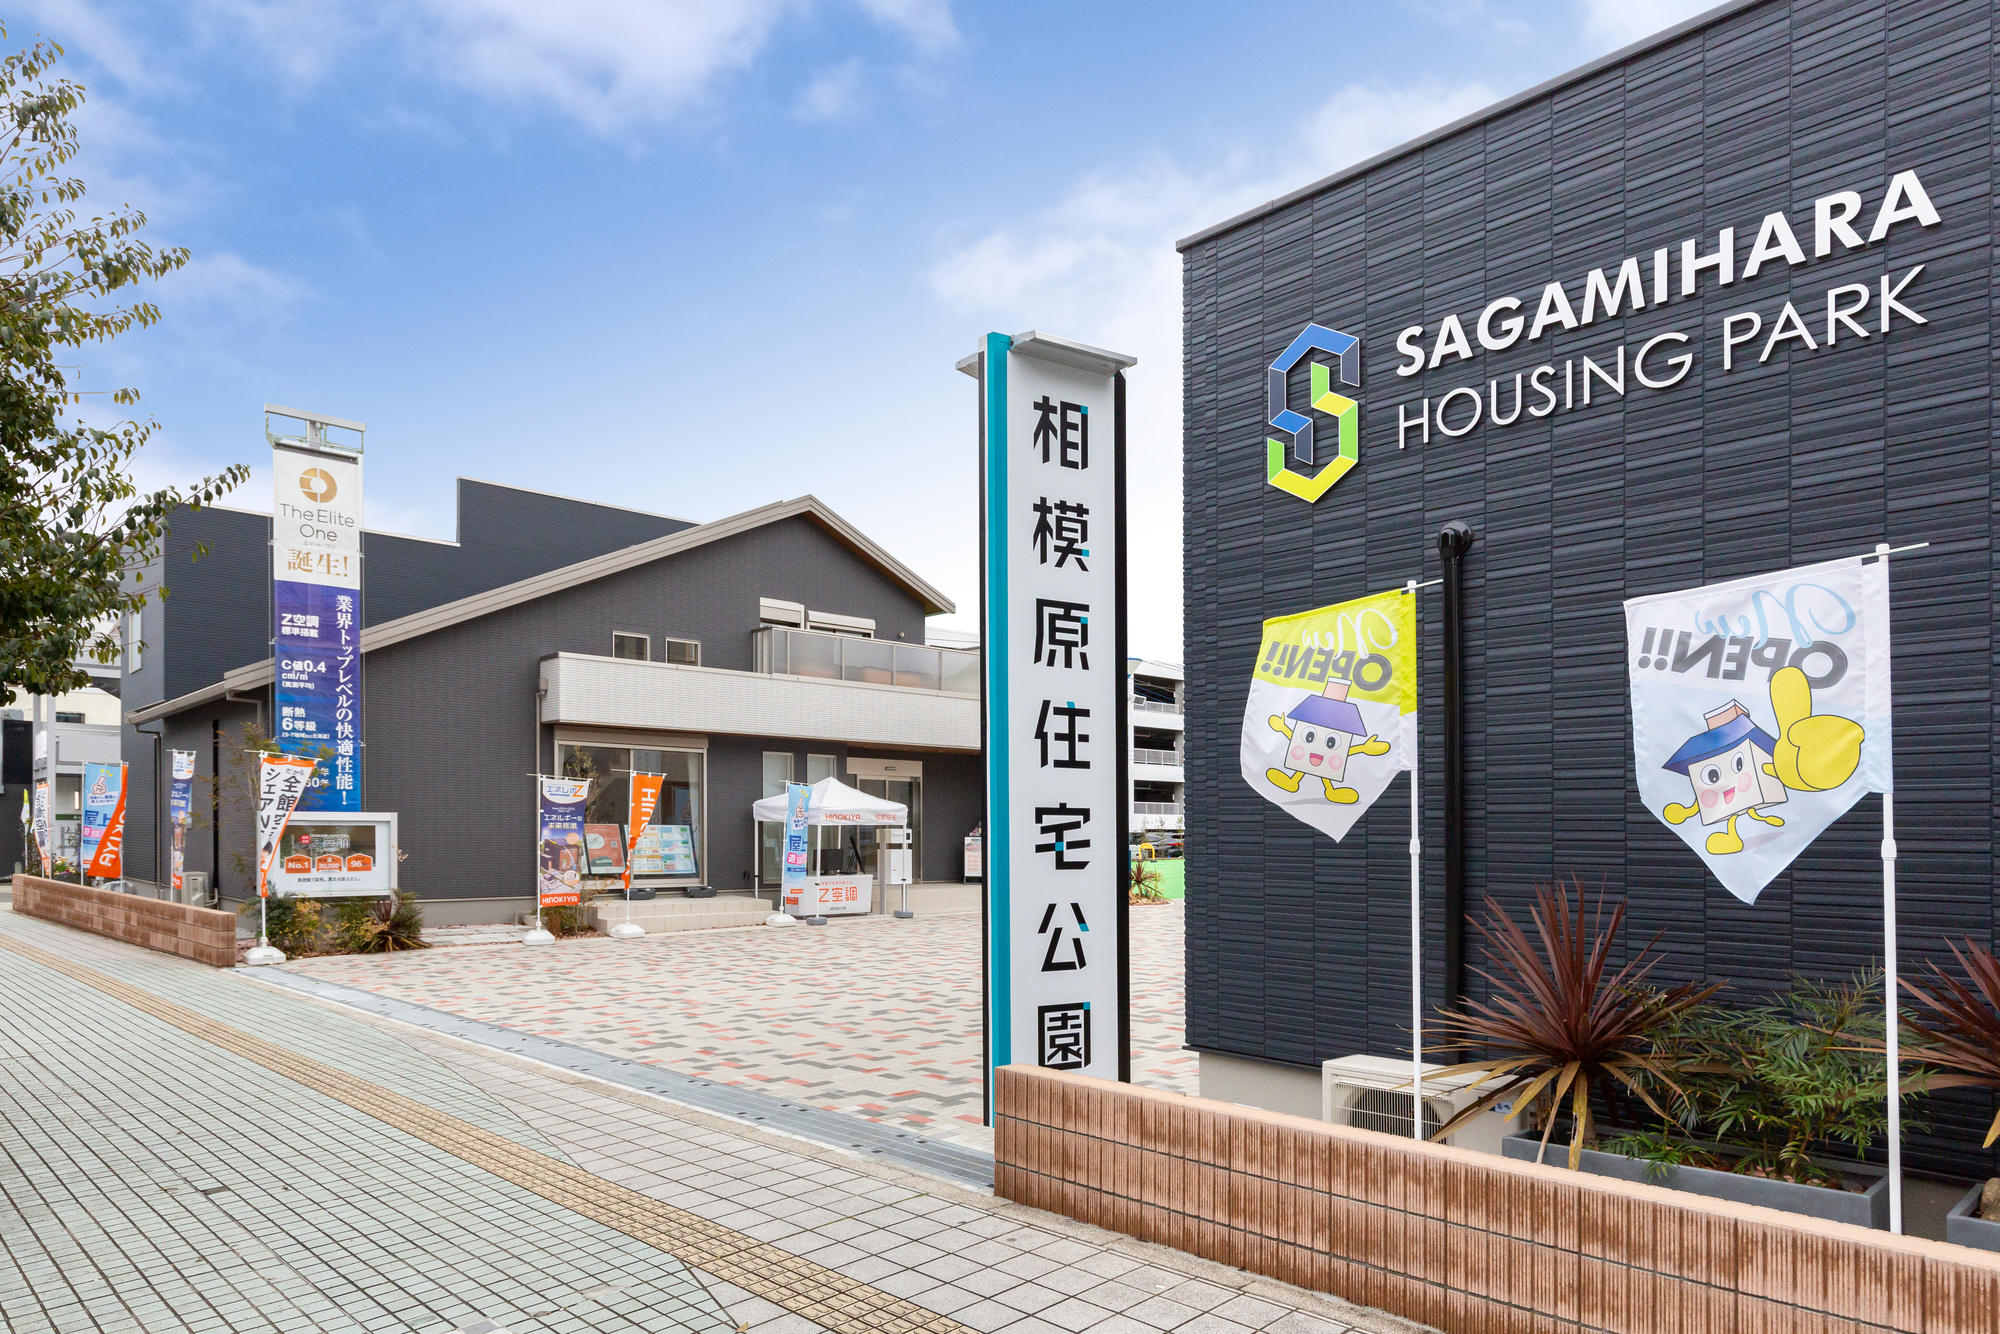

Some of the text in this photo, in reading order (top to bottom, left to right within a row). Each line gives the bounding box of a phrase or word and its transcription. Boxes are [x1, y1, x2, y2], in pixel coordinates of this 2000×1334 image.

[1396, 169, 1942, 377] SAGAMIHARA
[1399, 264, 1929, 449] HOUSING PARK
[279, 502, 354, 528] The Elite
[300, 524, 337, 542] One
[287, 548, 348, 578] 誕生!
[281, 613, 320, 628] Z空調
[281, 626, 319, 638] 標準搭載
[281, 660, 327, 673] C値0.4
[335, 594, 354, 806] 業界トップレベルの快適性能!
[282, 706, 306, 718] 断熱
[282, 717, 317, 731] 6等級
[1031, 394, 1092, 1071] 相模原住宅公園
[285, 768, 304, 776] だから
[541, 895, 578, 904] HINOKIYA
[818, 886, 858, 902] Z空調
